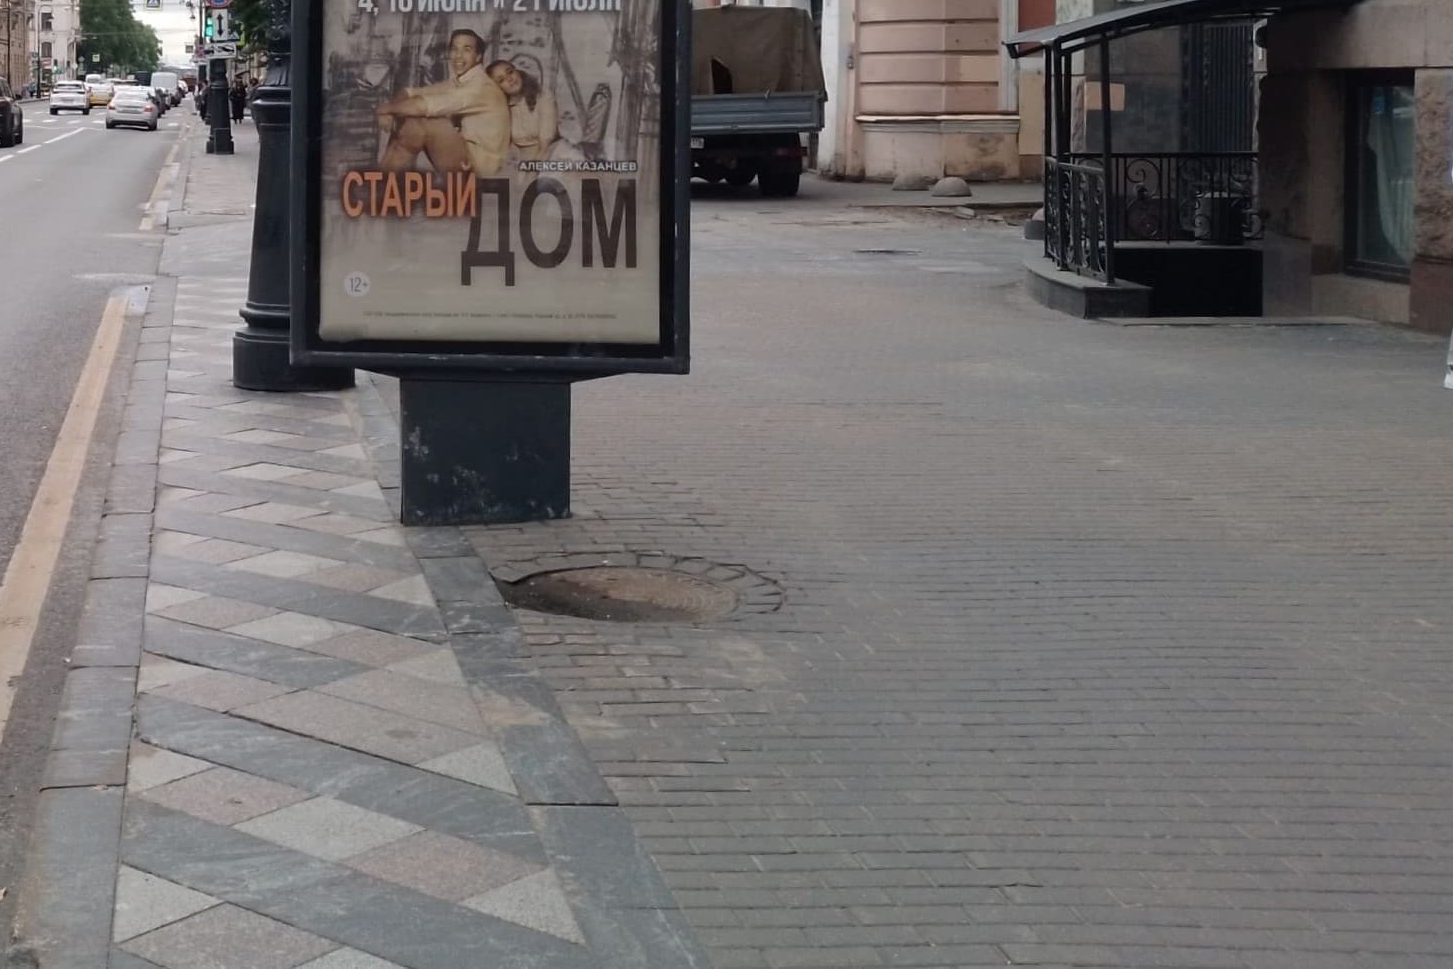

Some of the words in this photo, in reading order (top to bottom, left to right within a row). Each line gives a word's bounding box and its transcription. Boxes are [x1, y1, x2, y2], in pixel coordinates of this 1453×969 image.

[519, 159, 573, 172] АЛЕКСЕЙ
[575, 160, 638, 173] КАЗАНЦЕВ
[341, 161, 478, 218] СТАРЫЙ
[460, 177, 638, 288] ДОМ
[348, 276, 369, 294] 12+
